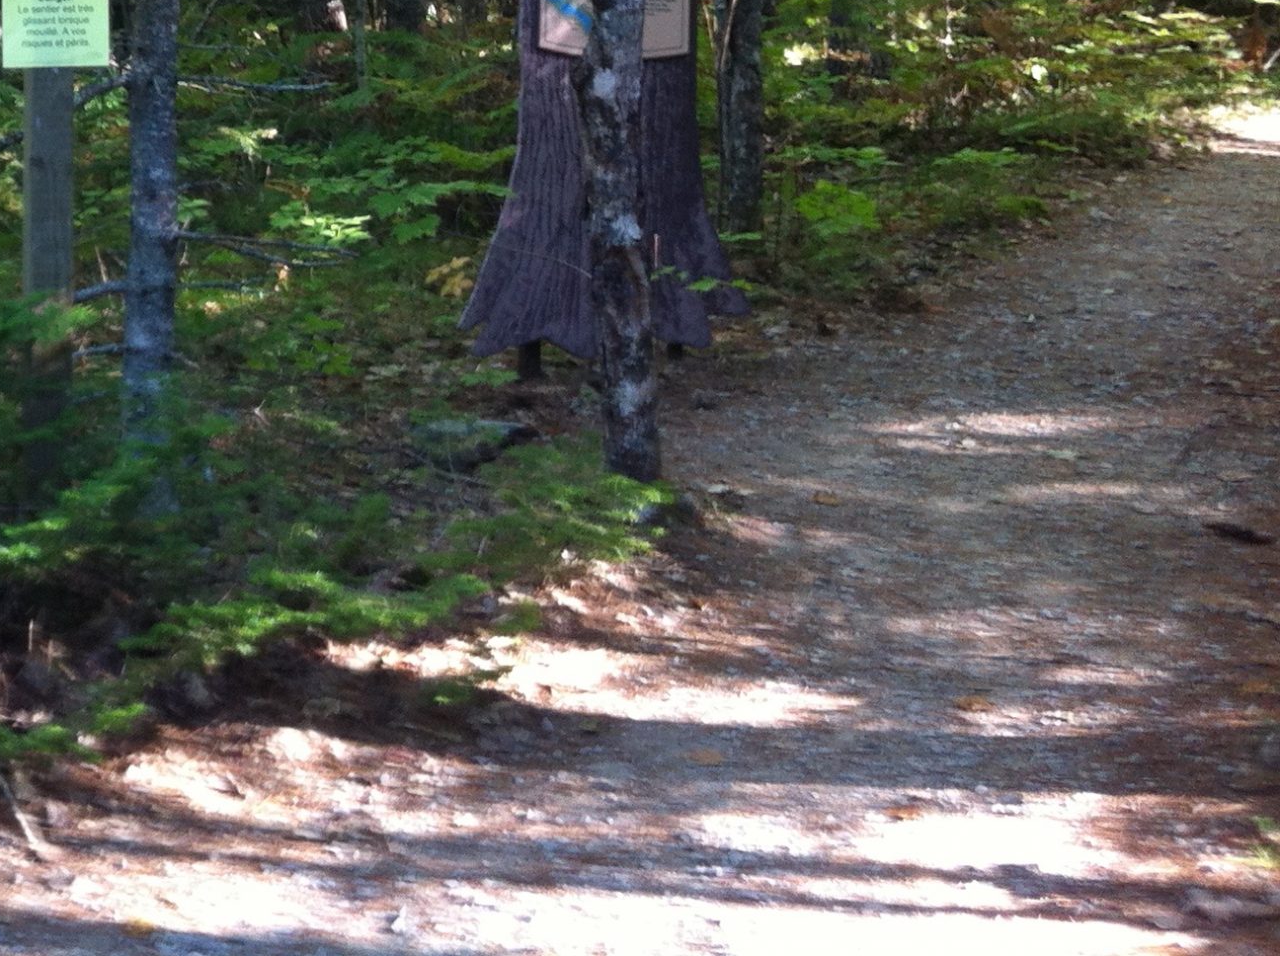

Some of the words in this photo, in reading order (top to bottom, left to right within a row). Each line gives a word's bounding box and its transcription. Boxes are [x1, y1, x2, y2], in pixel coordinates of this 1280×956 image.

[17, 5, 29, 14] Le
[31, 5, 60, 13] sentier
[62, 4, 76, 13] est
[54, 39, 64, 48] et
